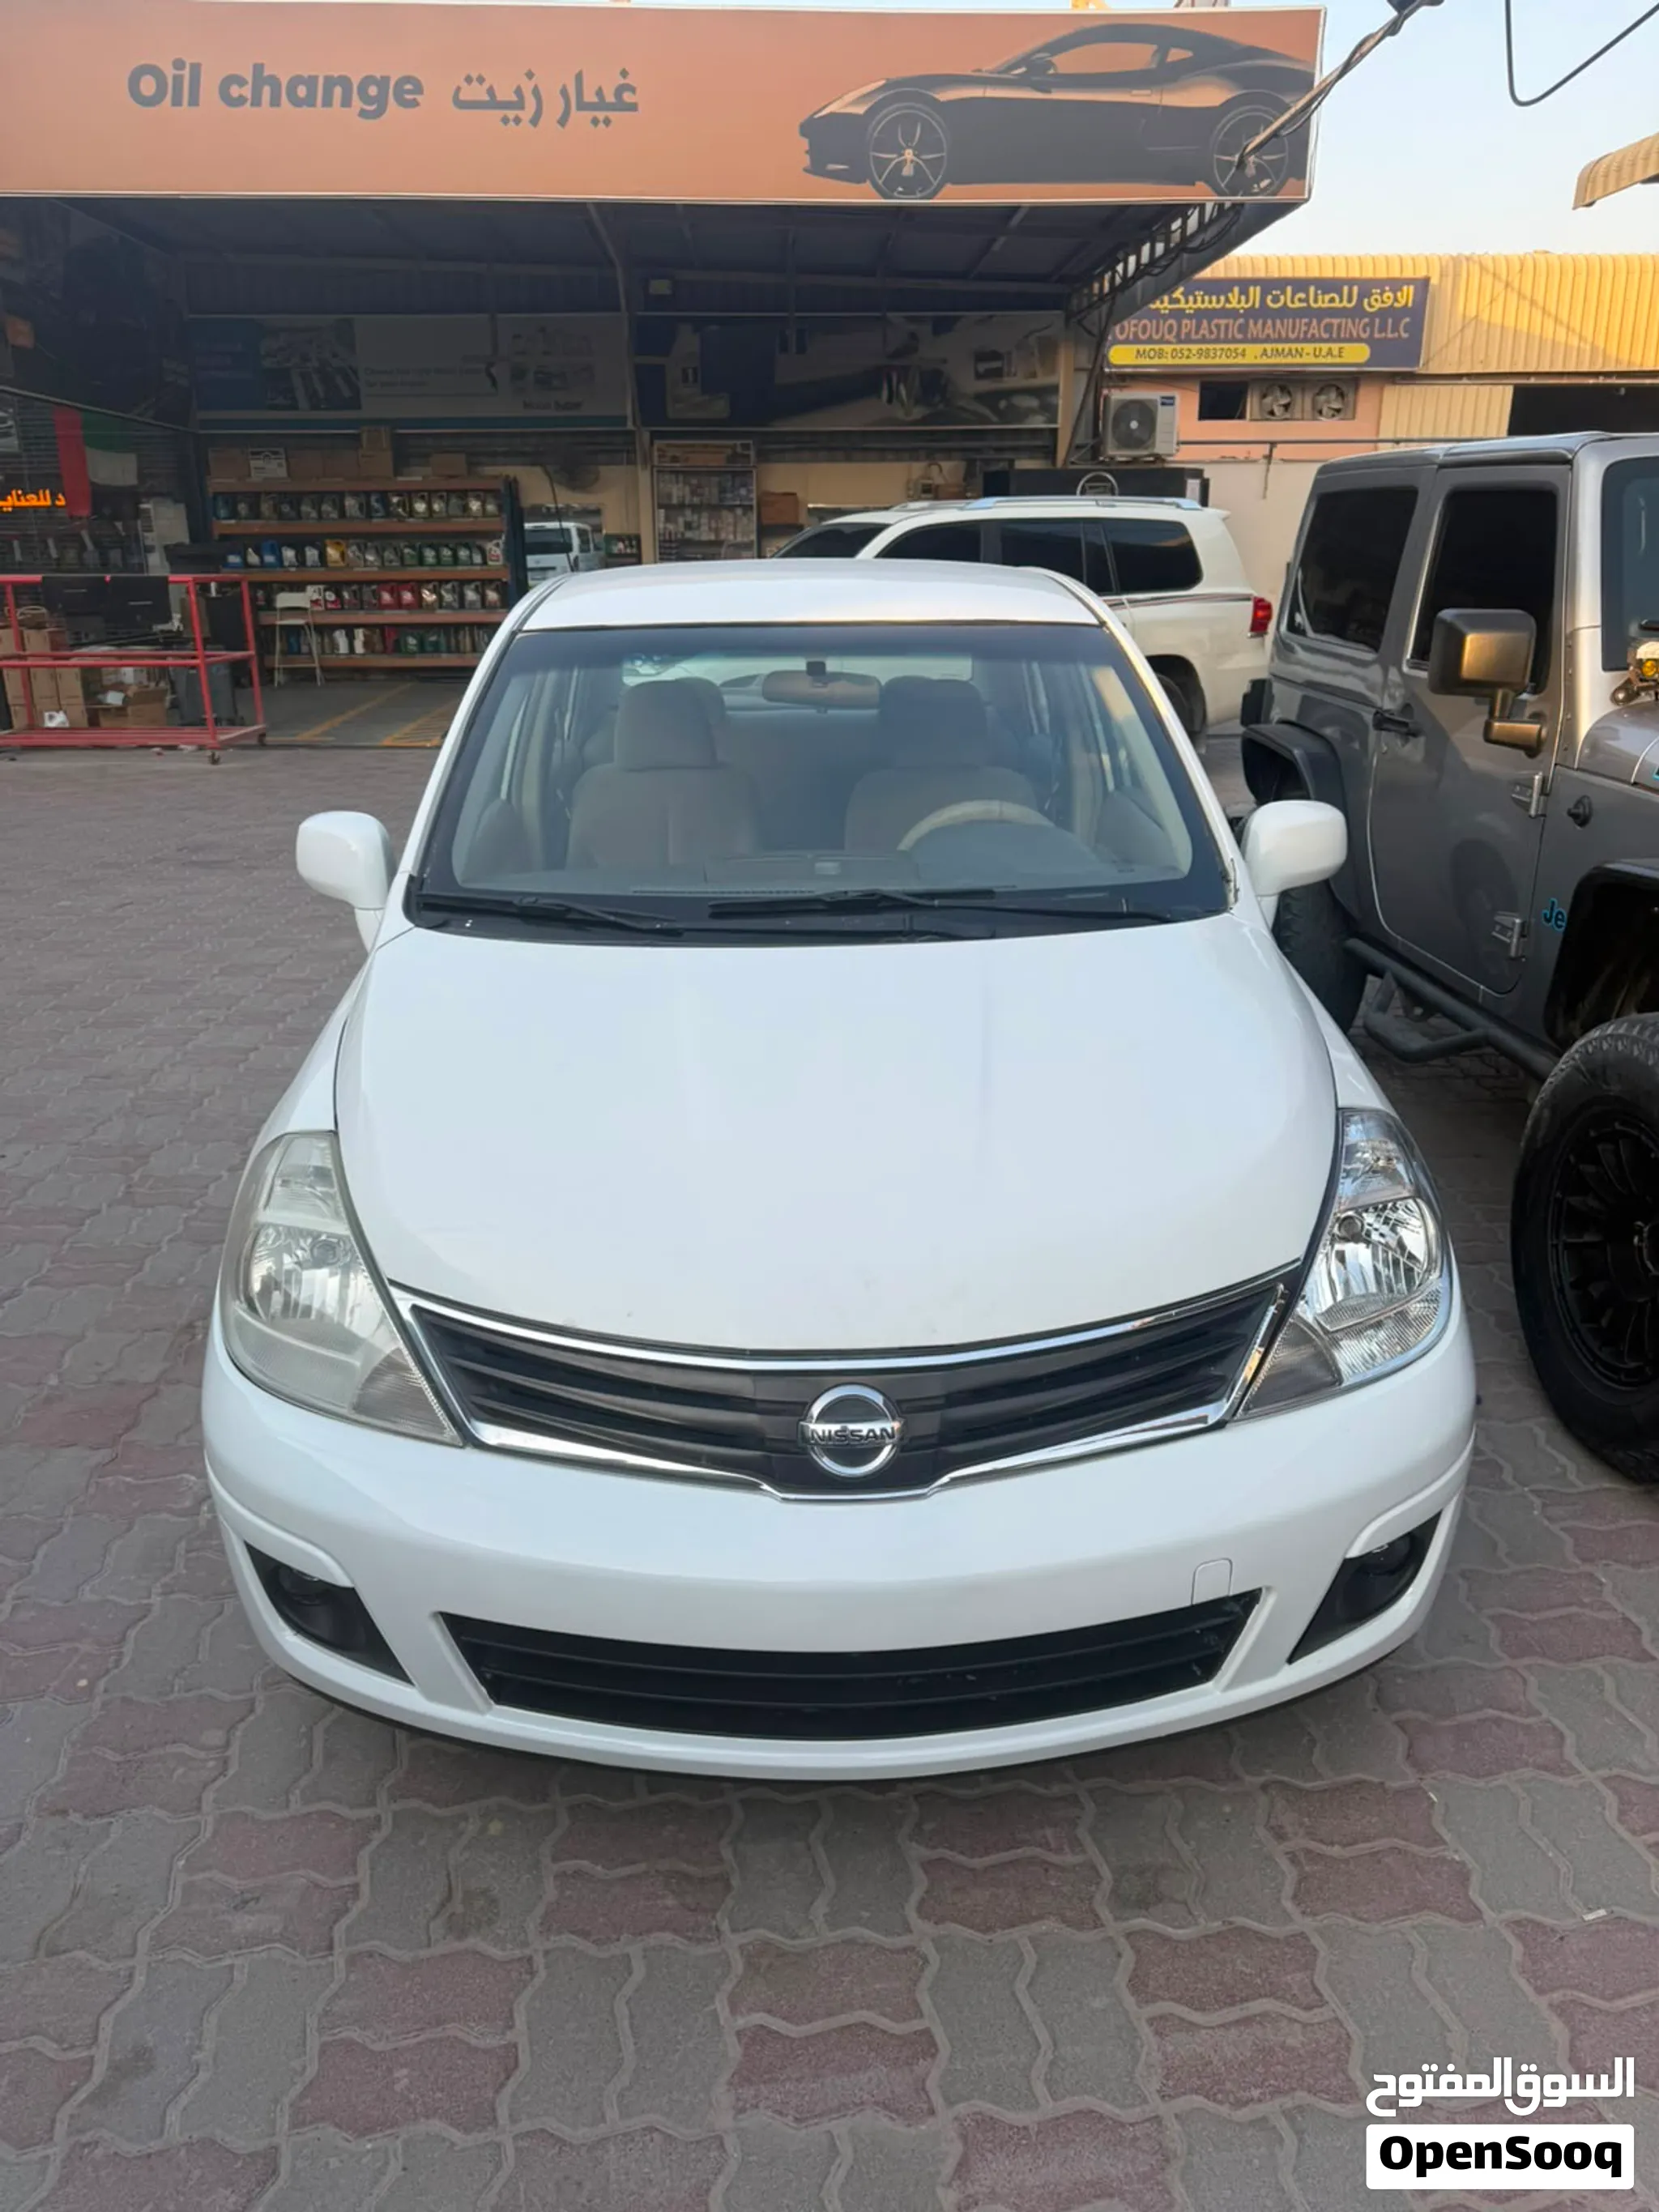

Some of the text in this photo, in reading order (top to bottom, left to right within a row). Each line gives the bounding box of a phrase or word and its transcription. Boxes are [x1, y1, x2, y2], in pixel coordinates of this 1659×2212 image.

[127, 58, 424, 121] Oil change
[451, 68, 639, 129] غيار زيت
[1149, 285, 1261, 314] البلاستيكي
[1266, 284, 1359, 309] للصناعات
[1181, 318, 1246, 339] PLASTIC
[1248, 318, 1371, 340] MANUFACTING
[1374, 318, 1411, 340] L.L.C
[1135, 347, 1166, 360] MOB:
[1171, 347, 1247, 360] 052-9837054
[1260, 347, 1305, 359] AJMAN
[1313, 347, 1345, 359] U.A.E
[0, 488, 52, 512] للعناي
[1542, 897, 1567, 931] Je
[810, 1426, 896, 1443] NISSAN
